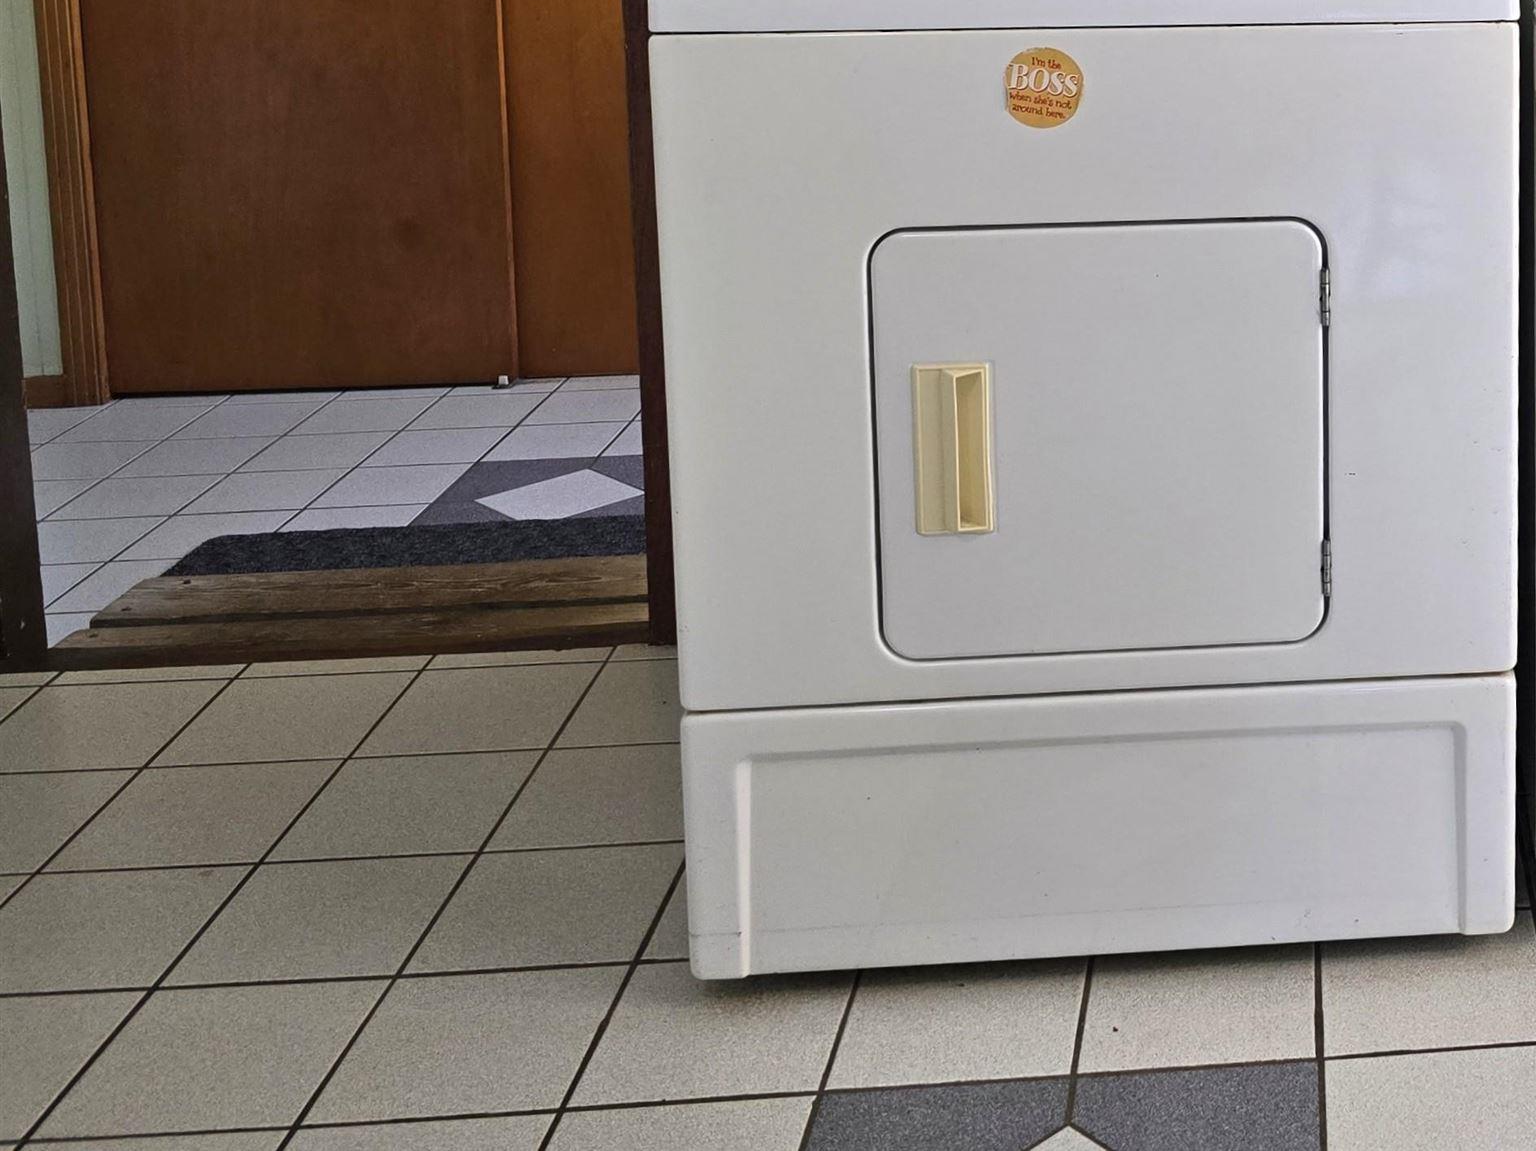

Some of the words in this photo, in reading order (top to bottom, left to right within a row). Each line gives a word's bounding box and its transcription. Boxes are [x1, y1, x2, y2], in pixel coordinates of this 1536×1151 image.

[1048, 59, 1062, 70] the
[1007, 63, 1080, 98] BOSS
[1009, 92, 1031, 103] when
[1011, 104, 1042, 115] around
